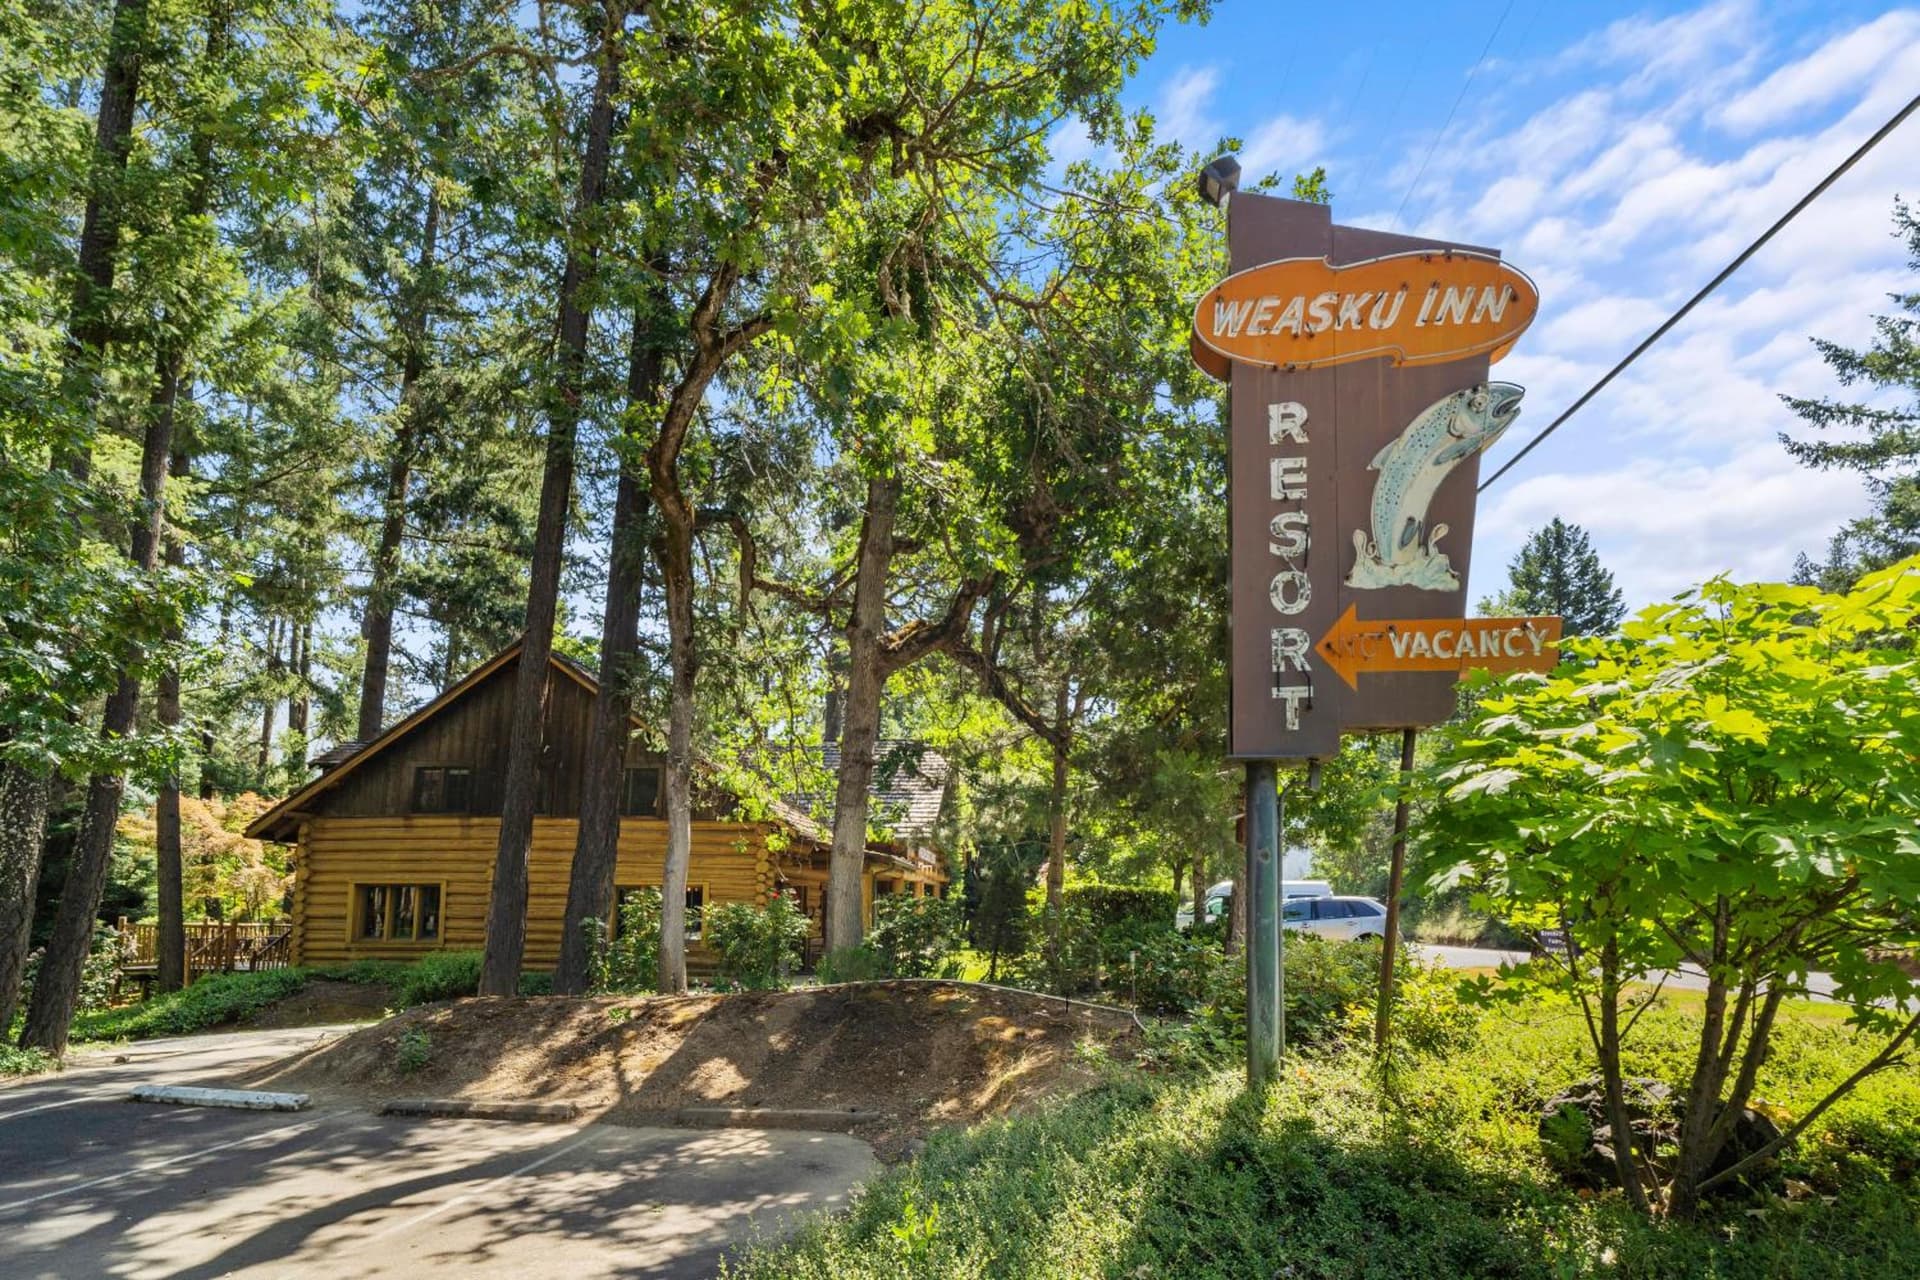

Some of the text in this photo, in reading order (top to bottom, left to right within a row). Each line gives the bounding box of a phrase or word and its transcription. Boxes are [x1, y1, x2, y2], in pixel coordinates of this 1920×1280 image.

[1213, 283, 1513, 338] WEASKU INN
[1268, 401, 1313, 730] RESORT
[1388, 629, 1550, 659] VACANCY
